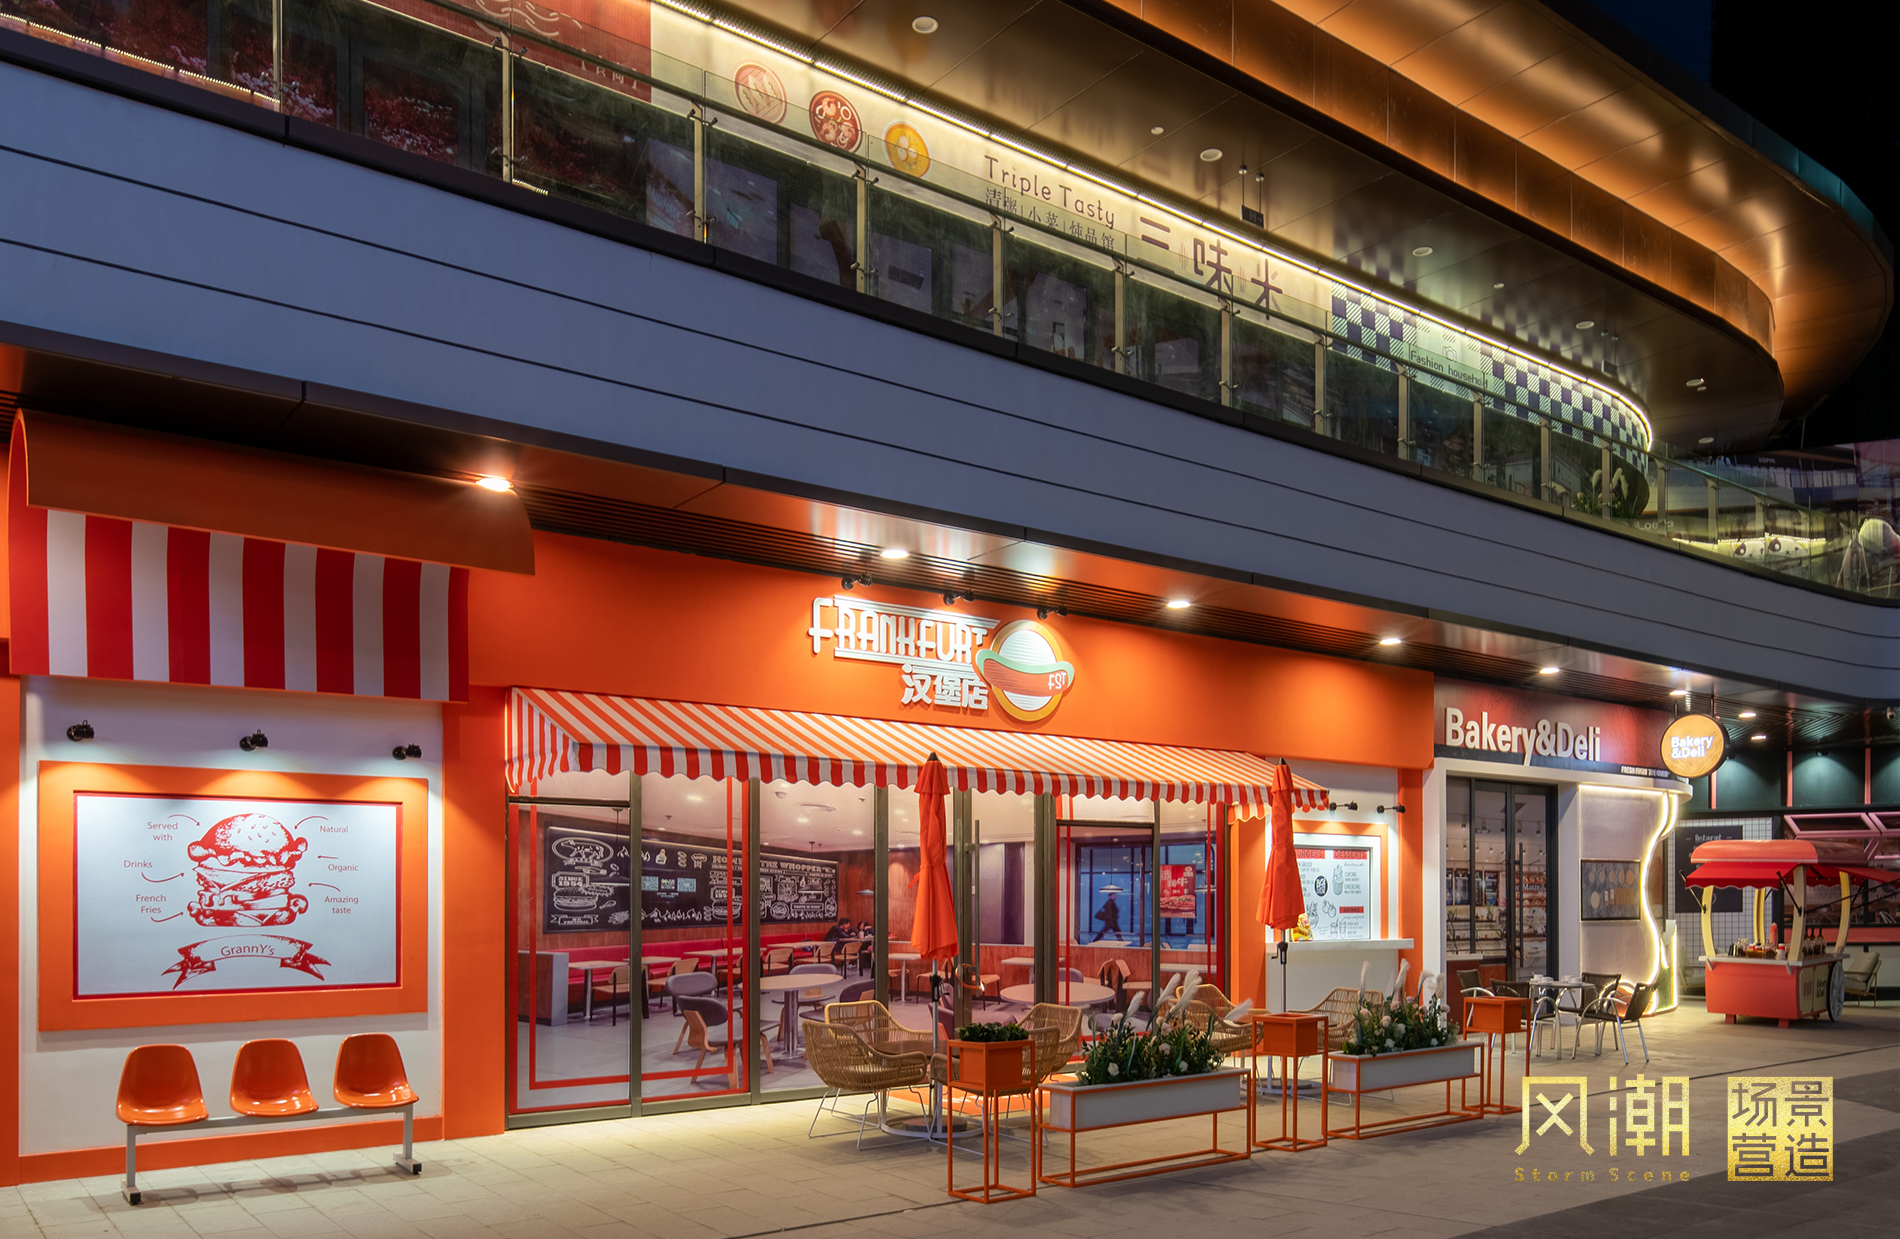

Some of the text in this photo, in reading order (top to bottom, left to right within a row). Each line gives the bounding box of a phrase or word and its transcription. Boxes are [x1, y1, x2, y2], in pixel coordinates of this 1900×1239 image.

[984, 154, 1115, 230] Triple Tasty
[1411, 350, 1444, 372] Fashion
[808, 597, 988, 664] FRANKFURT
[901, 663, 988, 710] 汉堡店
[1047, 671, 1067, 691] FST
[1446, 706, 1600, 766] Bakery&Deli
[1670, 735, 1714, 750] Bakery
[1670, 746, 1706, 759] &Deli
[147, 820, 179, 831] Served
[319, 824, 349, 834] Natural
[152, 833, 173, 842] with
[1297, 849, 1323, 859] URGERS
[1334, 850, 1366, 859] DESSERTS
[123, 859, 153, 869] Drinks
[327, 863, 359, 874] Organic
[135, 893, 167, 902] French
[324, 895, 359, 907] Amazing
[140, 905, 162, 914] Fries
[331, 905, 351, 914] taste
